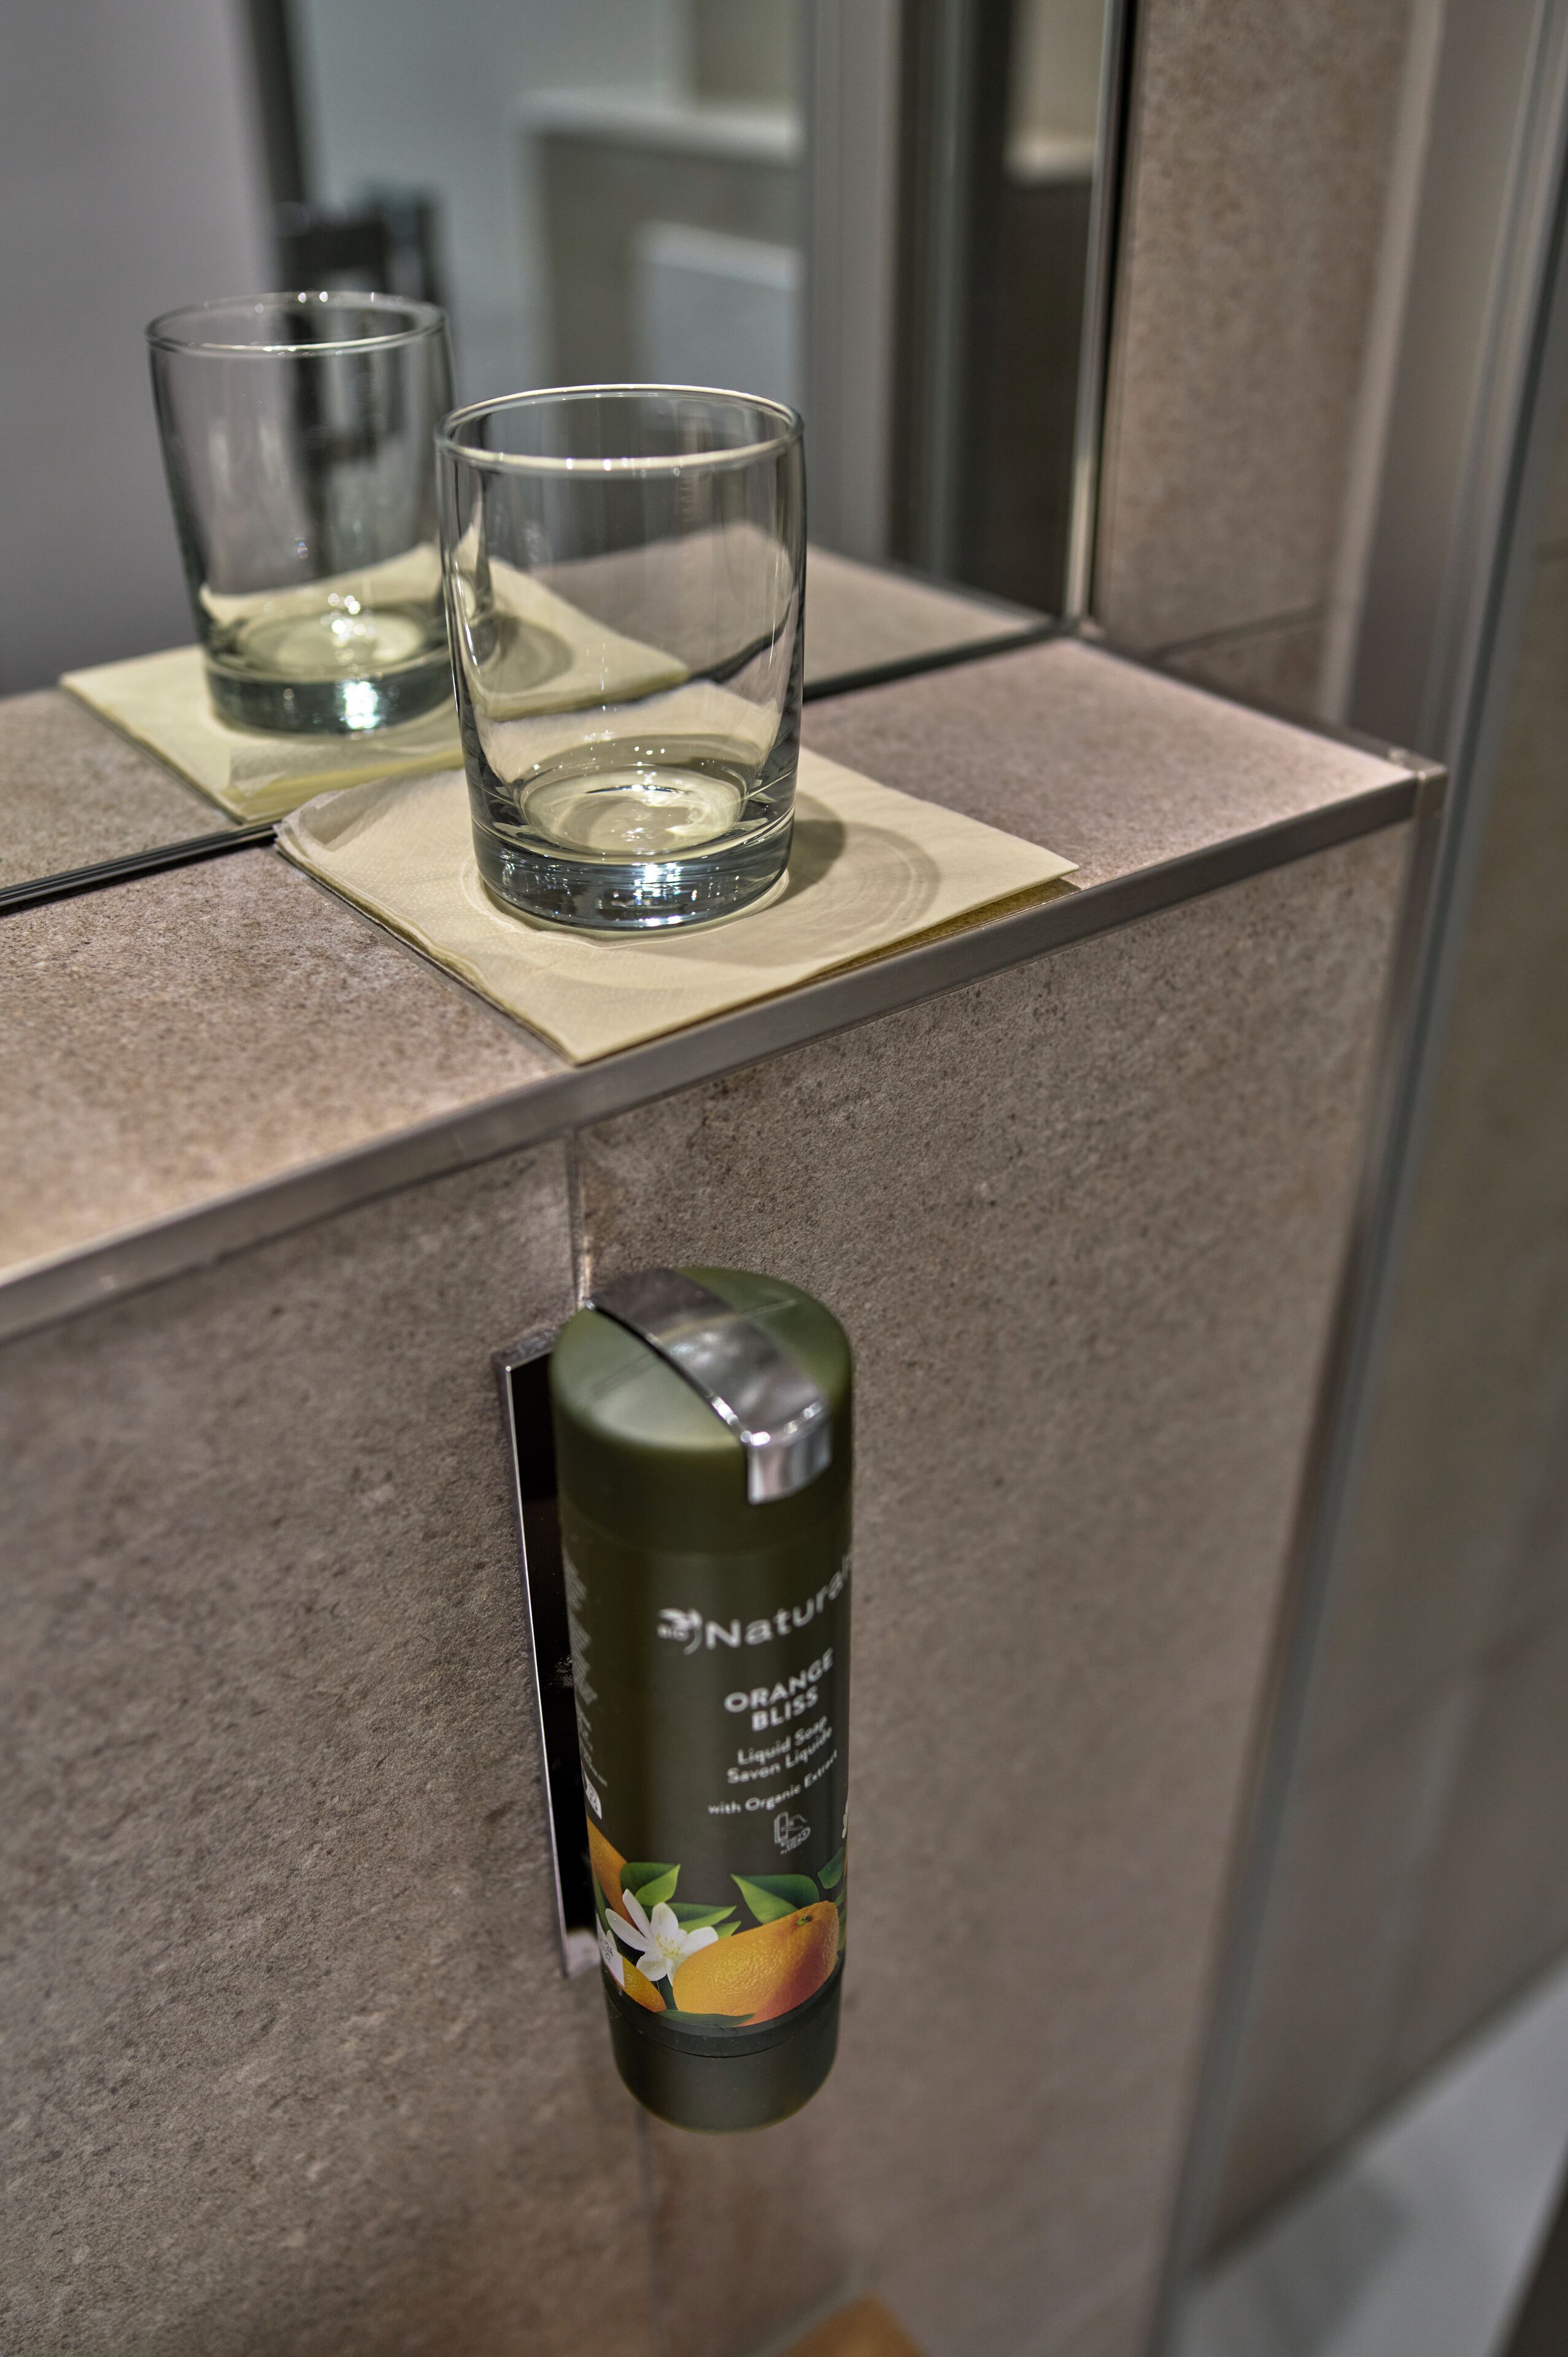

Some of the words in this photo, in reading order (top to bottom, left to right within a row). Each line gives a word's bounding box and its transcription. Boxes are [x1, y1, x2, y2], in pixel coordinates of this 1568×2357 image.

[724, 1647, 833, 1713] ORANGE
[752, 1685, 818, 1732] BLISS
[727, 1763, 781, 1783] Savon
[786, 1727, 832, 1768] Liquide
[738, 1735, 791, 1765] Liquid
[794, 1716, 827, 1746] Soap
[708, 1800, 742, 1814] with
[745, 1784, 801, 1811] Organic
